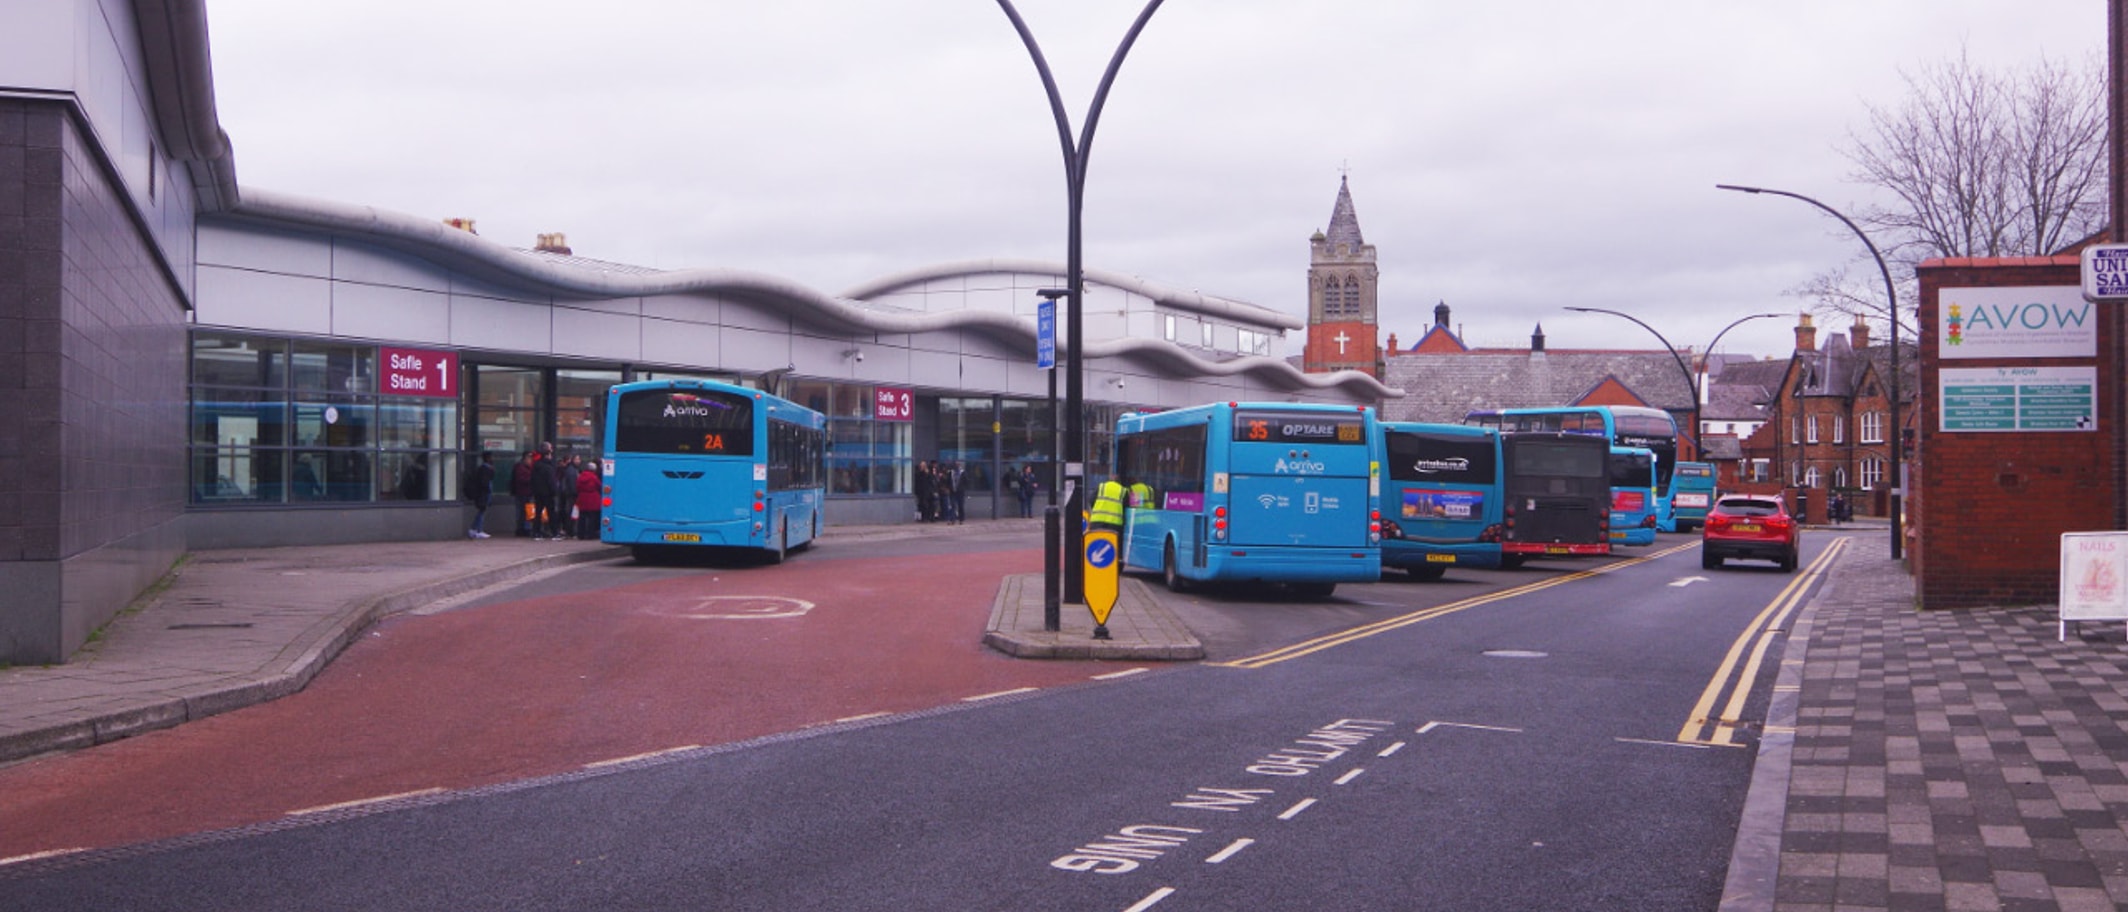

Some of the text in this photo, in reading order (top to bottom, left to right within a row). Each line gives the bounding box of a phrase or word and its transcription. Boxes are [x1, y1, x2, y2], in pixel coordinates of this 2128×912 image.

[2096, 273, 2128, 286] SA
[1965, 303, 2090, 330] AVOW
[390, 353, 422, 371] Safle
[436, 358, 447, 391] 1
[2011, 368, 2038, 376] AVOW
[390, 373, 427, 390] Stand
[676, 406, 708, 416] arriva
[878, 405, 897, 416] Stand
[901, 393, 910, 417] 3
[1248, 420, 1268, 439] 35
[1282, 424, 1335, 436] OPTARE
[704, 434, 723, 449] 2A
[1289, 460, 1324, 471] arriva
[2079, 541, 2116, 552] NAILS
[1171, 787, 1275, 812] YN
[1050, 824, 1203, 874] UNIG
